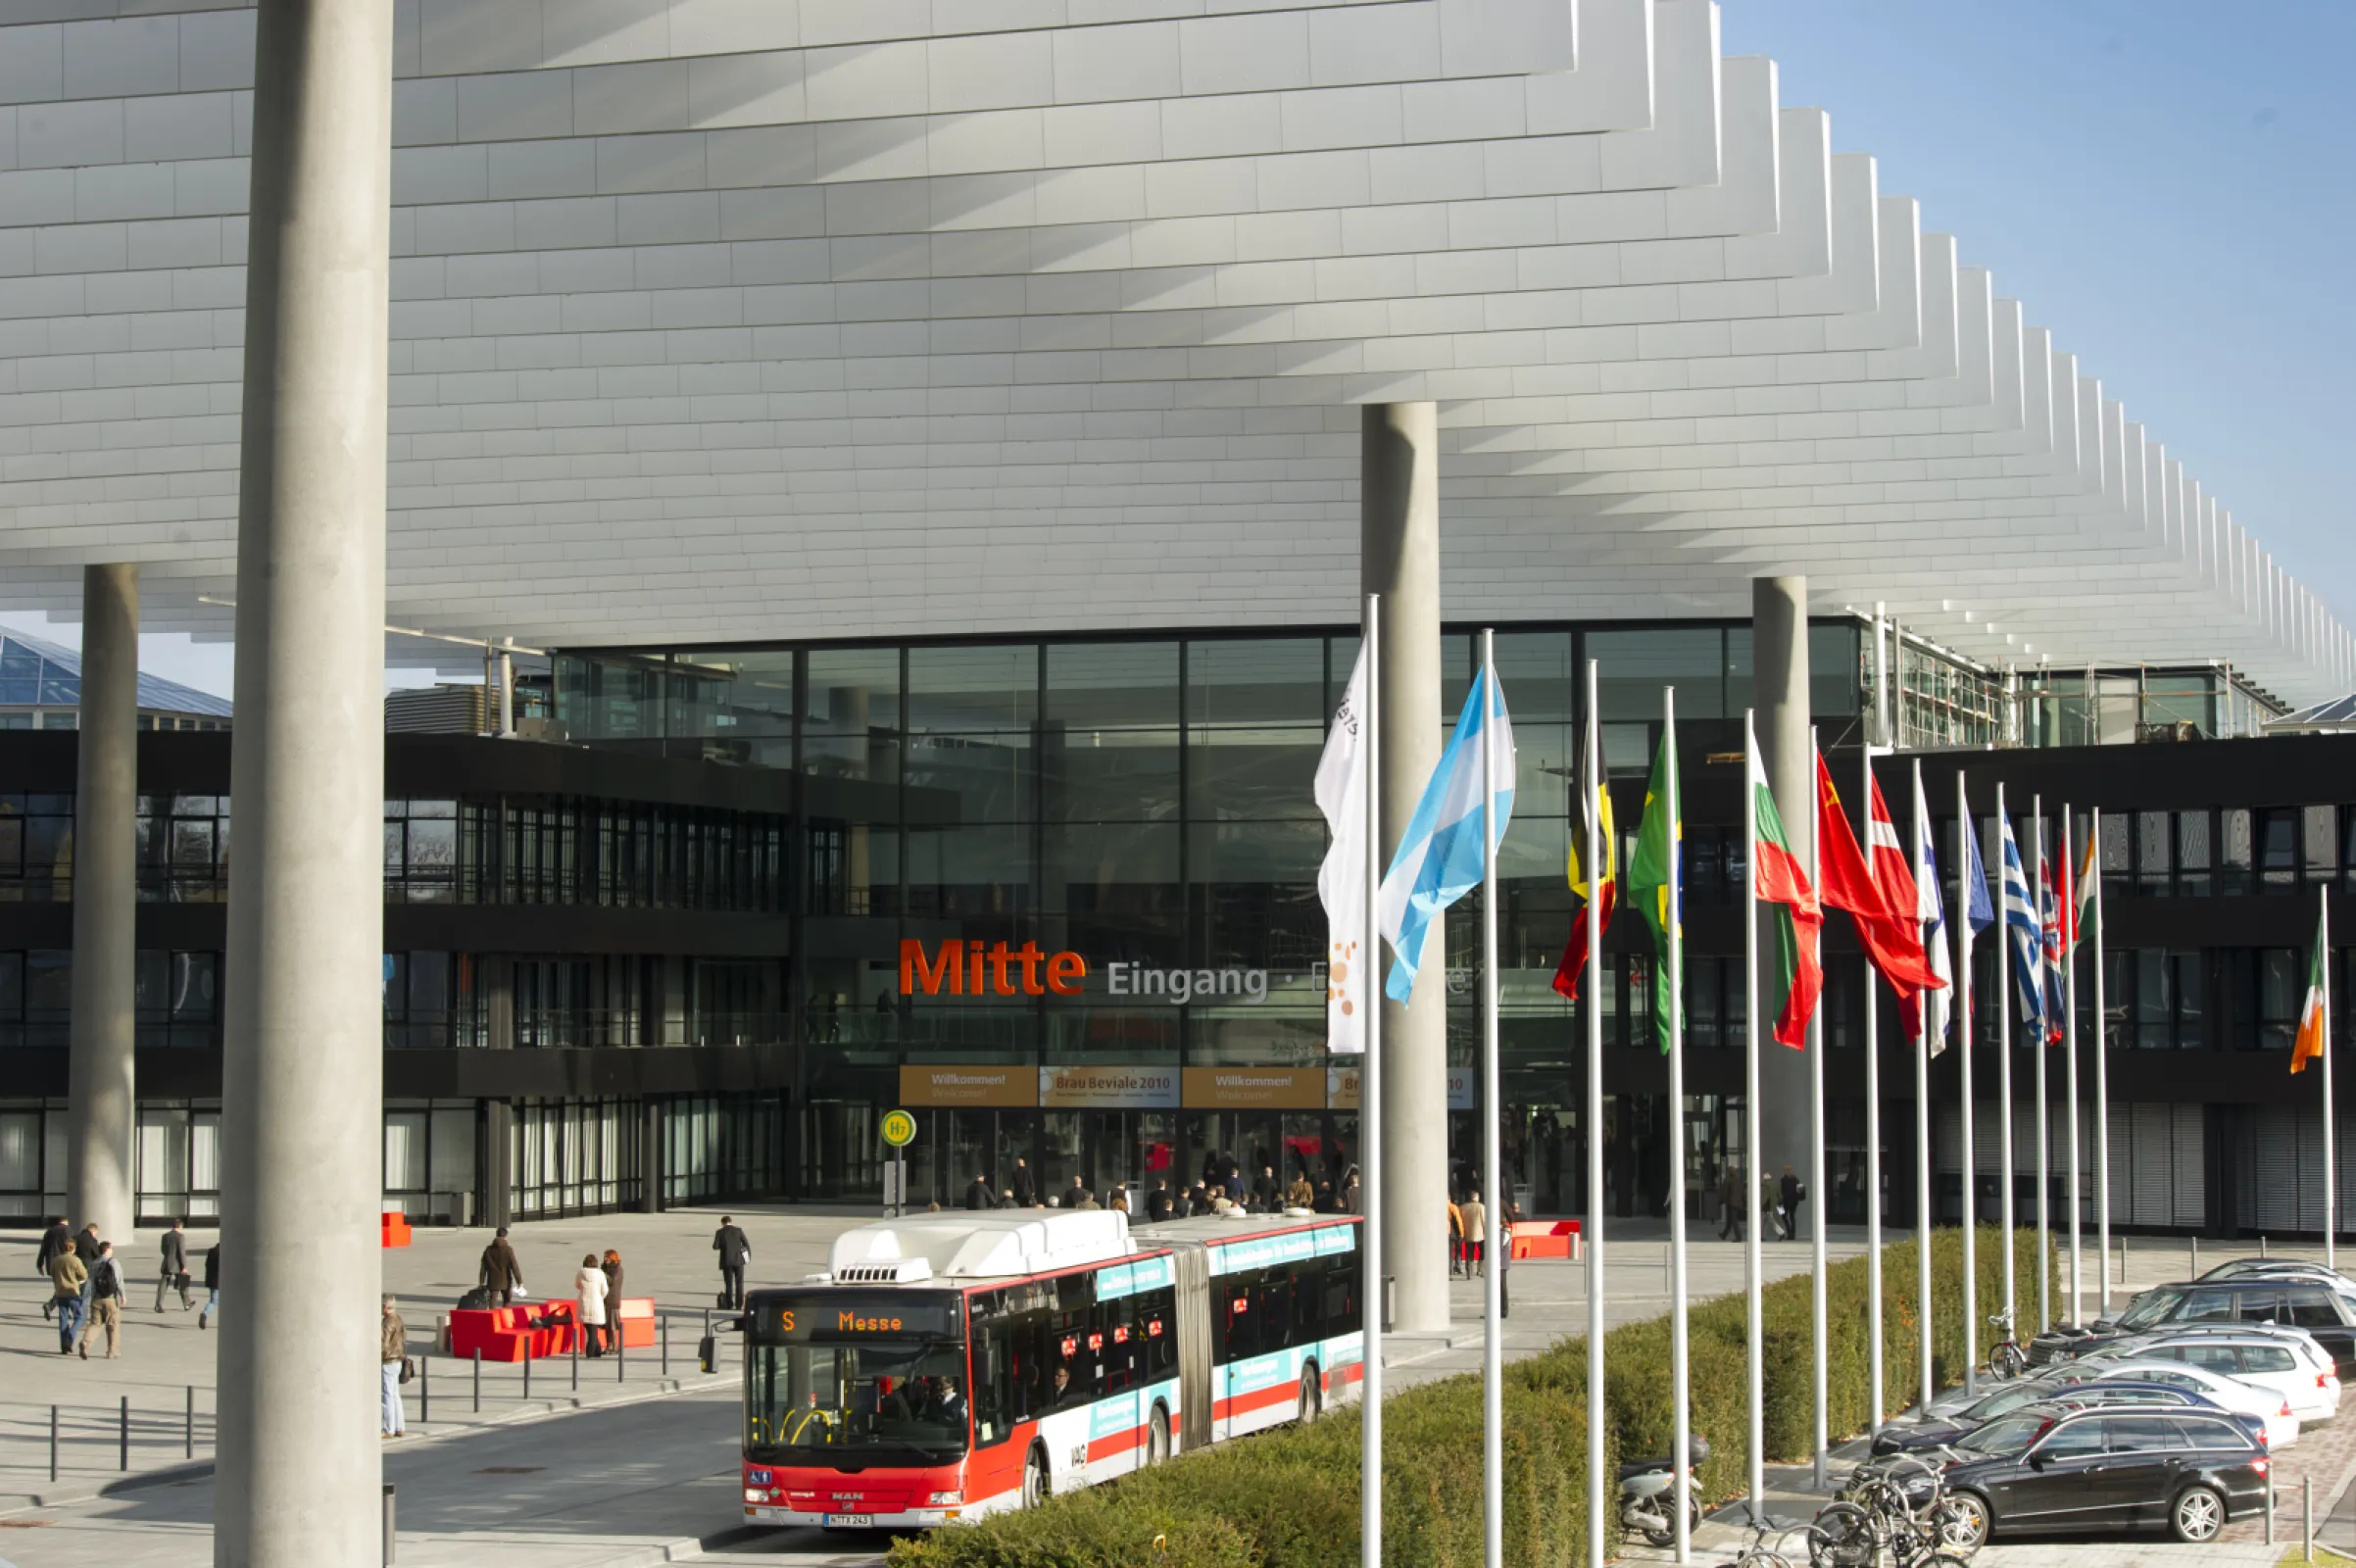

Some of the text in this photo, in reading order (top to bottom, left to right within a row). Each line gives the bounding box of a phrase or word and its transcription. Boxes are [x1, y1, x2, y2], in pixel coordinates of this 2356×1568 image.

[899, 939, 1087, 996] Mitte
[1107, 961, 1268, 1004] Eingang
[931, 1074, 1006, 1085] Willkommen!
[1056, 1075, 1170, 1089] Brau Beviale 2010
[1215, 1074, 1293, 1087] Willkommen!
[1345, 1078, 1463, 1090] Br 10
[782, 1310, 902, 1331] S Messe
[832, 1492, 863, 1500] MAN
